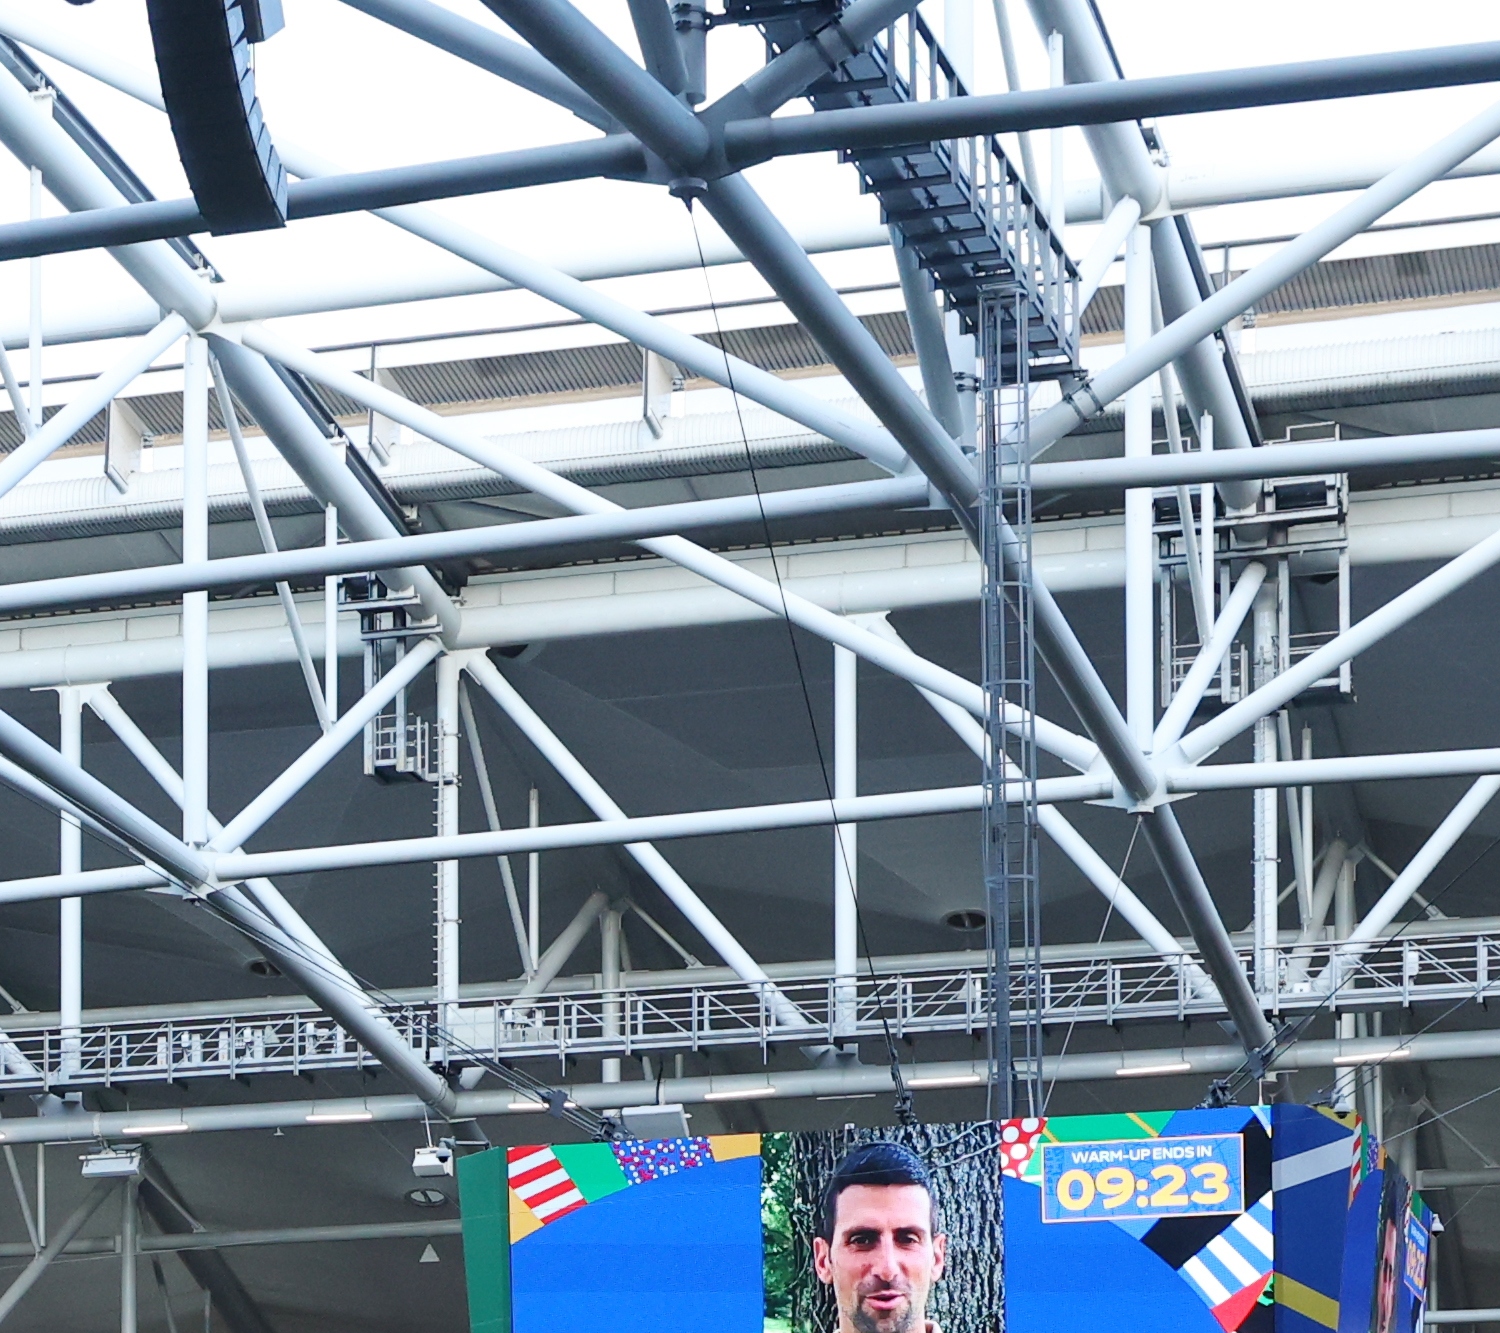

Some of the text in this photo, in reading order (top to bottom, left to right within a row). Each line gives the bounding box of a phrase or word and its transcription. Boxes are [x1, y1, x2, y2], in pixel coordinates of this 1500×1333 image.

[1071, 1146, 1212, 1163] WARM-UP ENDS IN
[1055, 1164, 1230, 1211] 09:23
